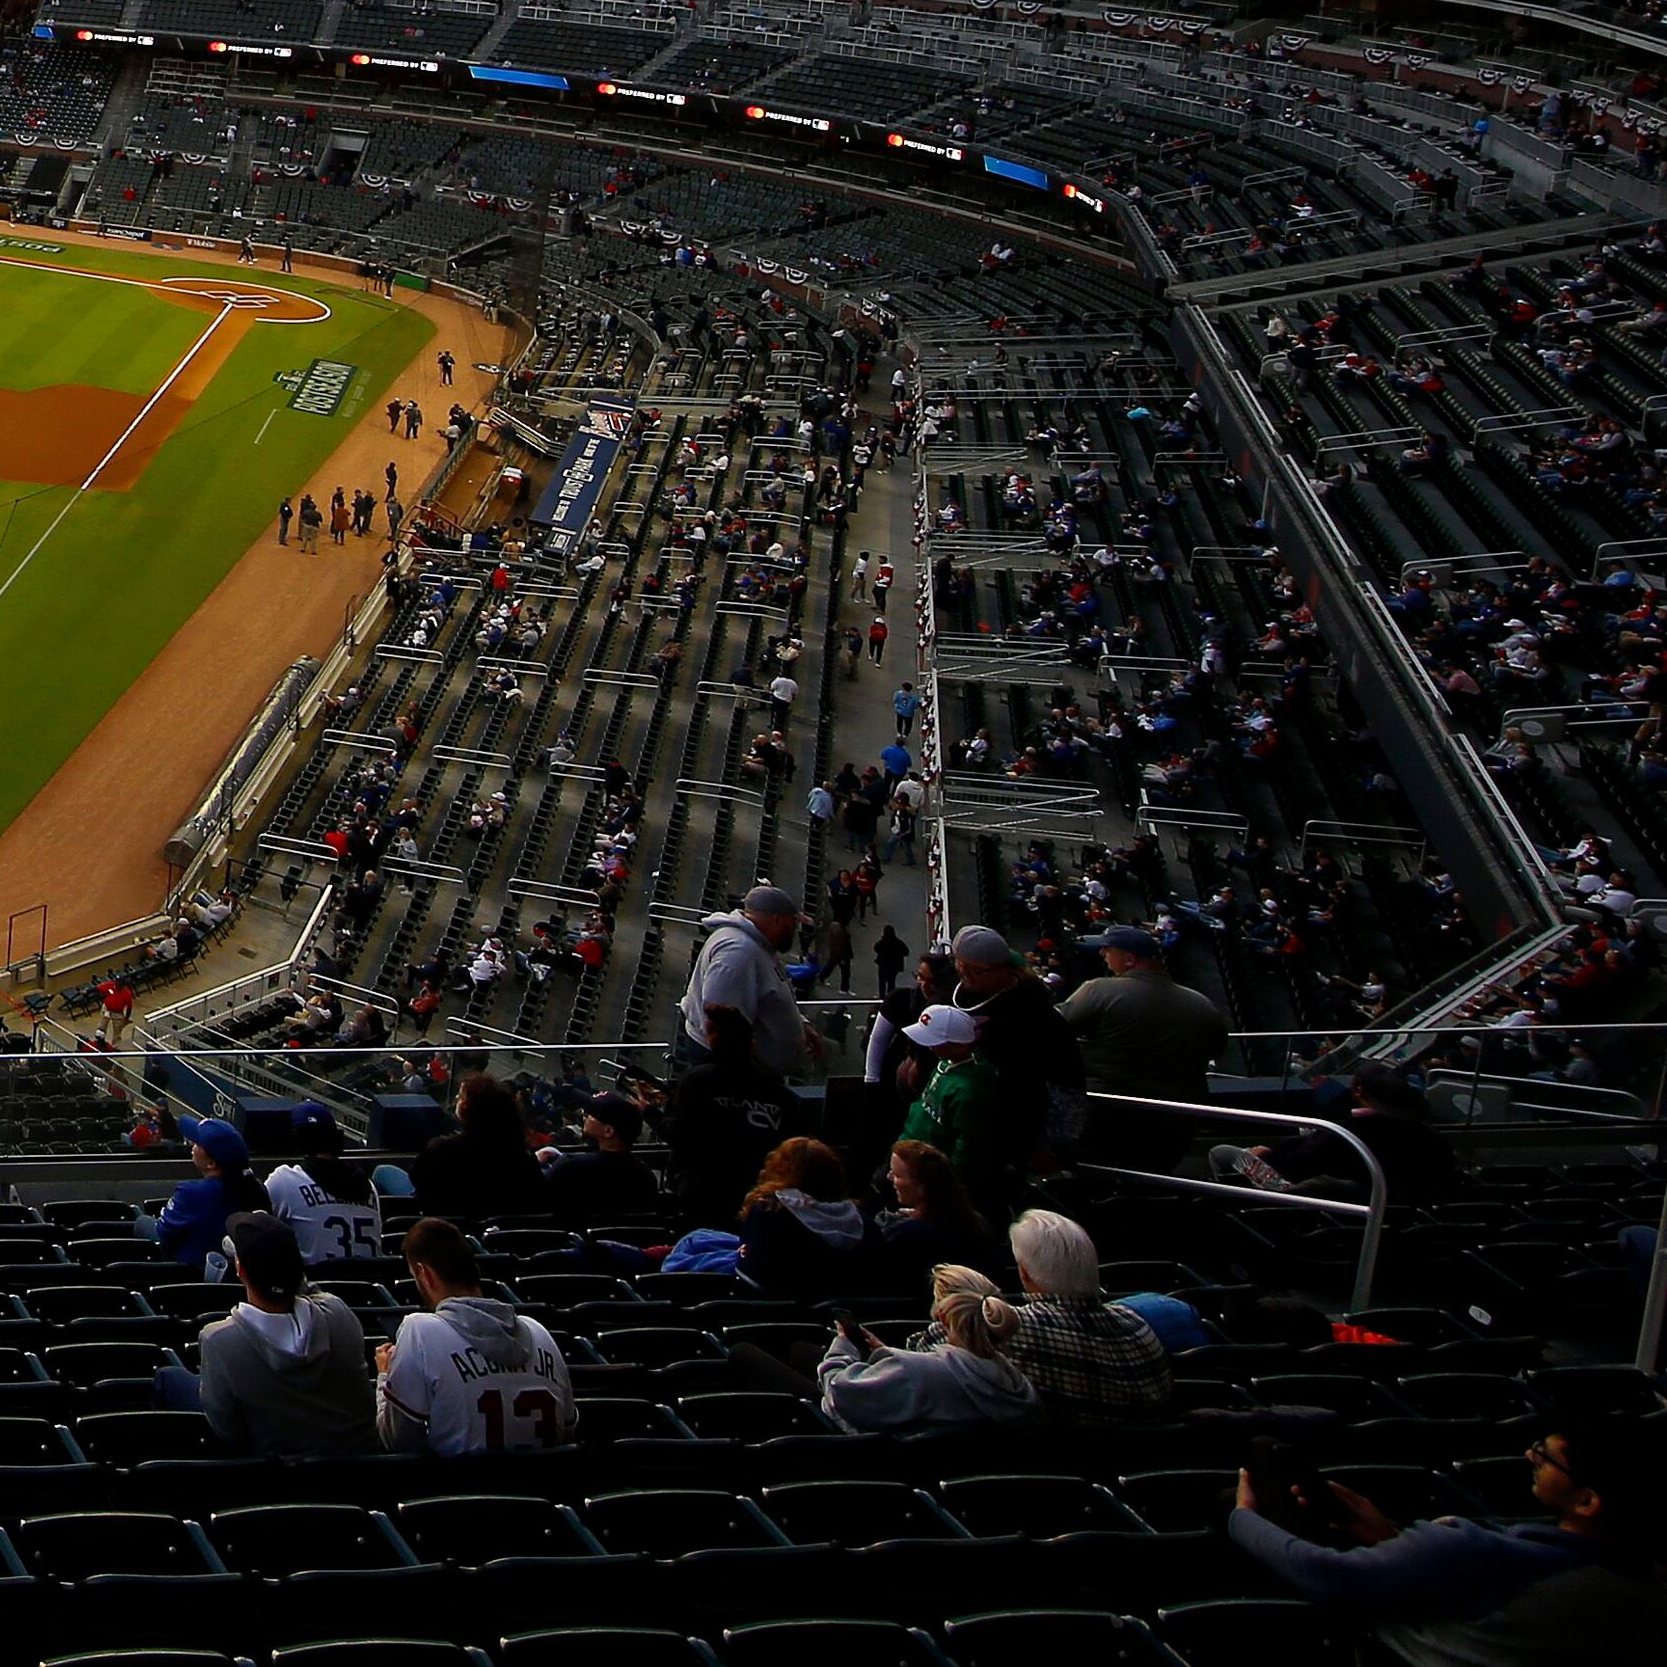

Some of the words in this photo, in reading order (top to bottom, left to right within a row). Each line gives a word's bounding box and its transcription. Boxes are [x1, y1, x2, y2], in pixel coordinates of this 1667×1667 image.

[293, 360, 353, 415] POSTSEASON
[558, 478, 584, 500] TRUIST
[571, 457, 595, 472] PARK
[323, 1216, 376, 1257] 35
[478, 1390, 556, 1449] 13
